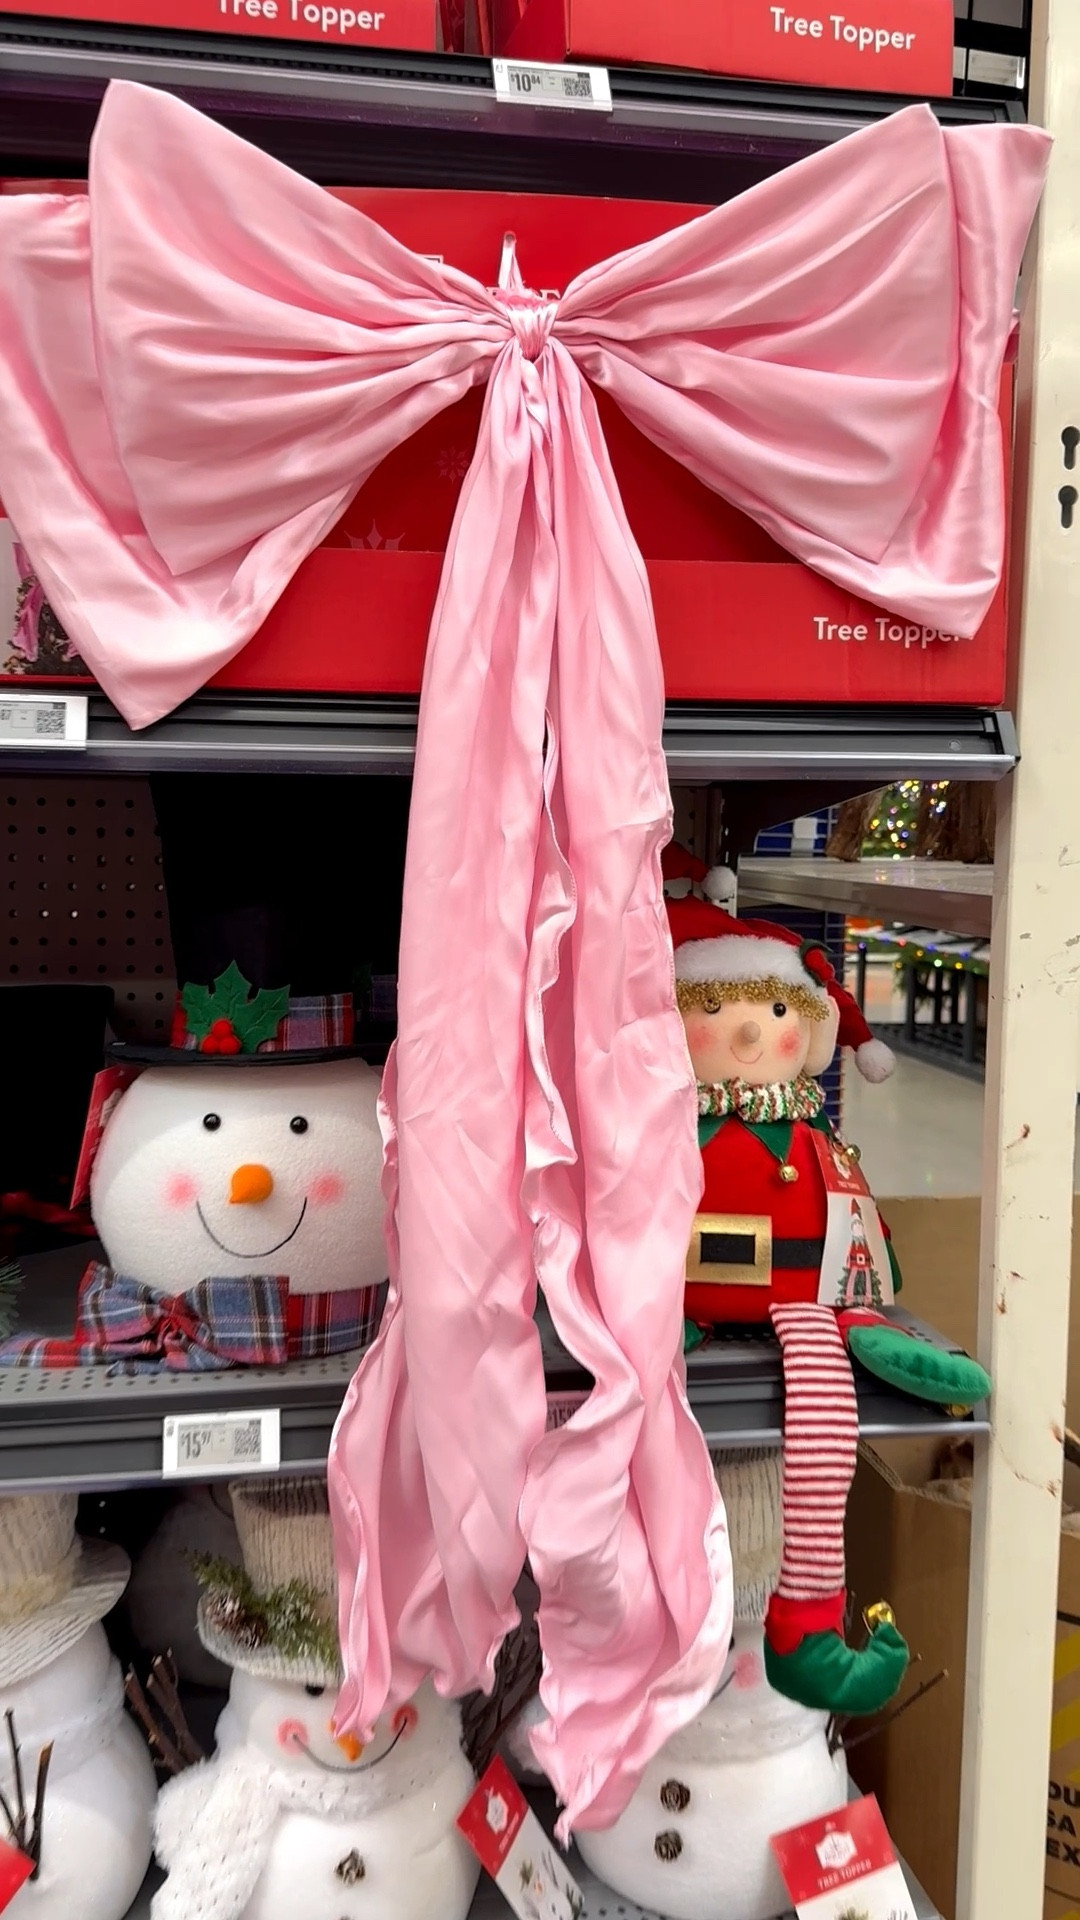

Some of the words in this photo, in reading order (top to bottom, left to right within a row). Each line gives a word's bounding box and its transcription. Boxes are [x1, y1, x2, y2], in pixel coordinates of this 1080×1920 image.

[289, 0, 386, 34] Topper
[770, 6, 824, 38] Tree
[830, 15, 916, 53] Topper
[813, 616, 868, 641] Tree
